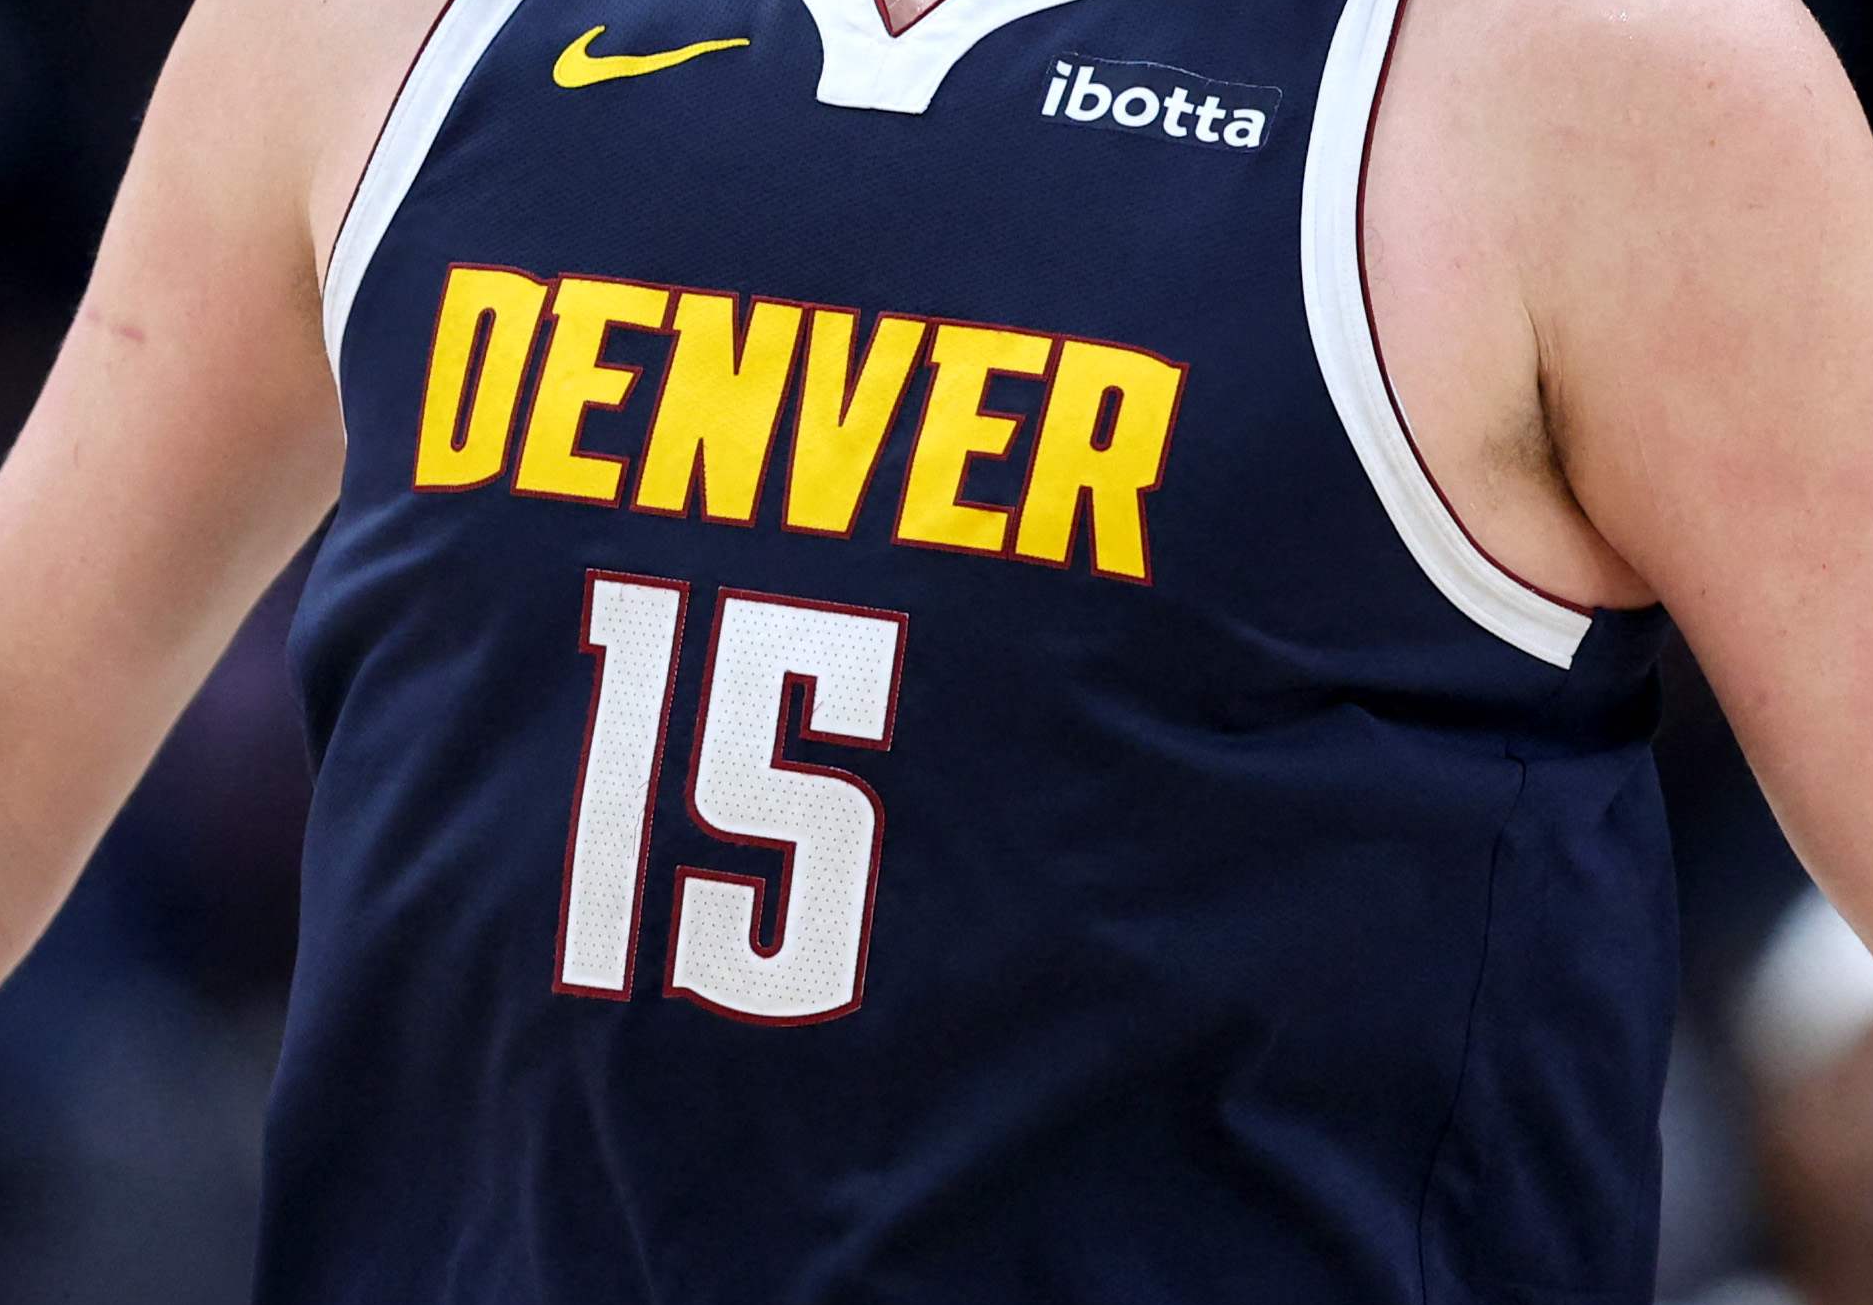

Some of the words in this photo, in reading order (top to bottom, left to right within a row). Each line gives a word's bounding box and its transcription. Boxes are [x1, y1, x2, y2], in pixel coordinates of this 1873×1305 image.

[1041, 60, 1266, 148] ibotta
[411, 262, 1189, 586] DENVER
[552, 568, 909, 1027] 15
